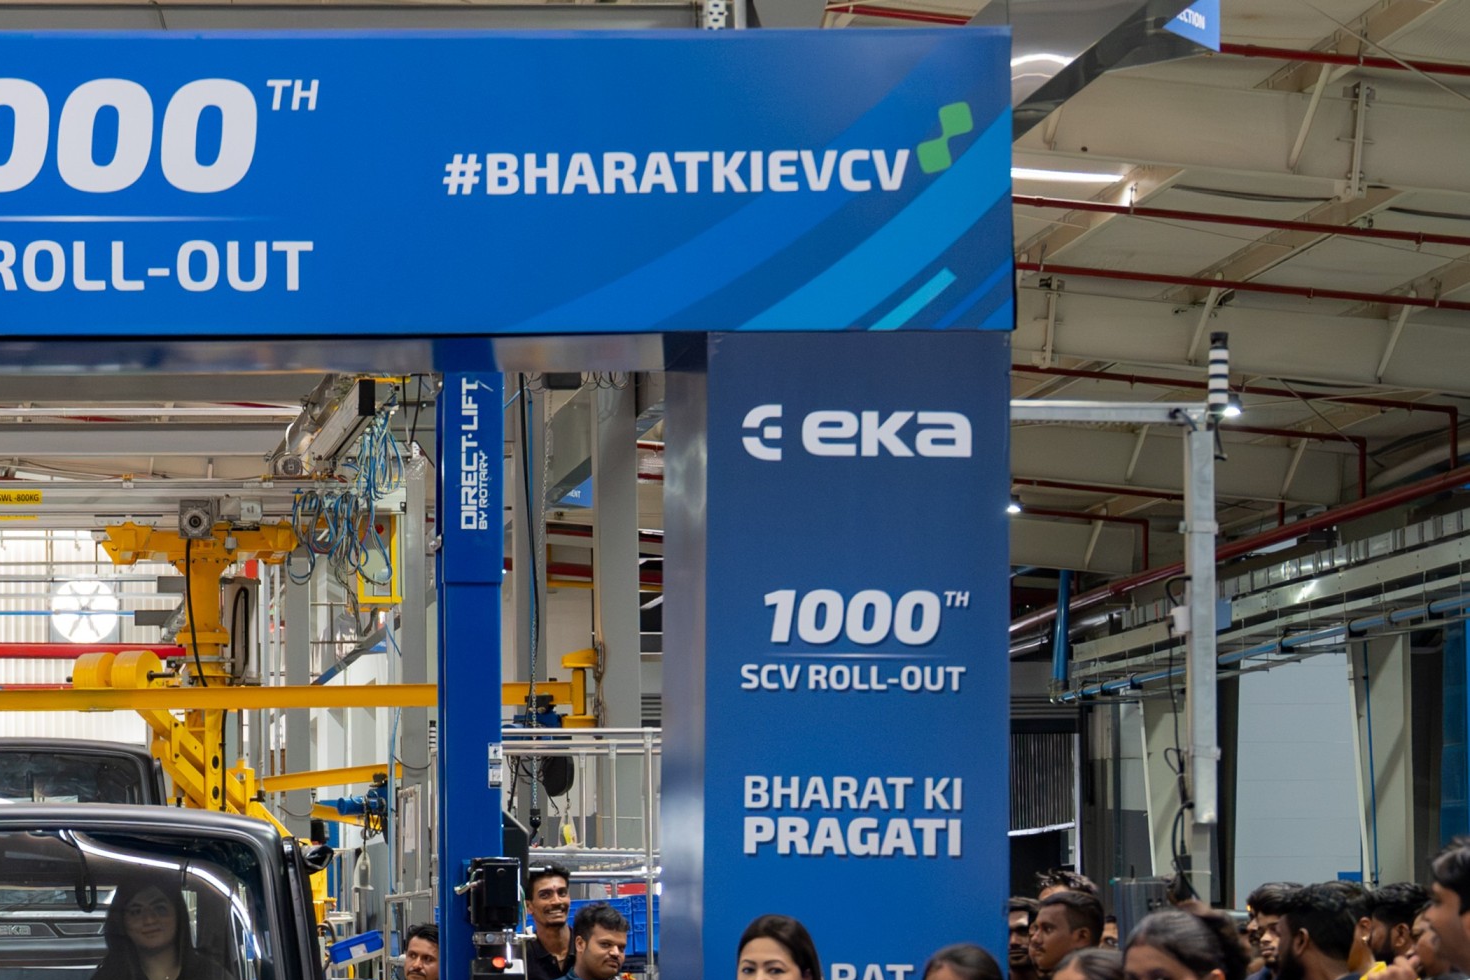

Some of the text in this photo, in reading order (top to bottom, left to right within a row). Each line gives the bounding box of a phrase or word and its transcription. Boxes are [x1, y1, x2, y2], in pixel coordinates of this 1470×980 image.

[442, 149, 910, 195] #BHARATKIEVCV
[801, 410, 972, 458] eka
[478, 511, 488, 530] BY
[740, 663, 966, 691] SCV ROLL-OUT
[744, 775, 962, 810] BHARAT KI
[743, 816, 962, 856] PRAGATI
